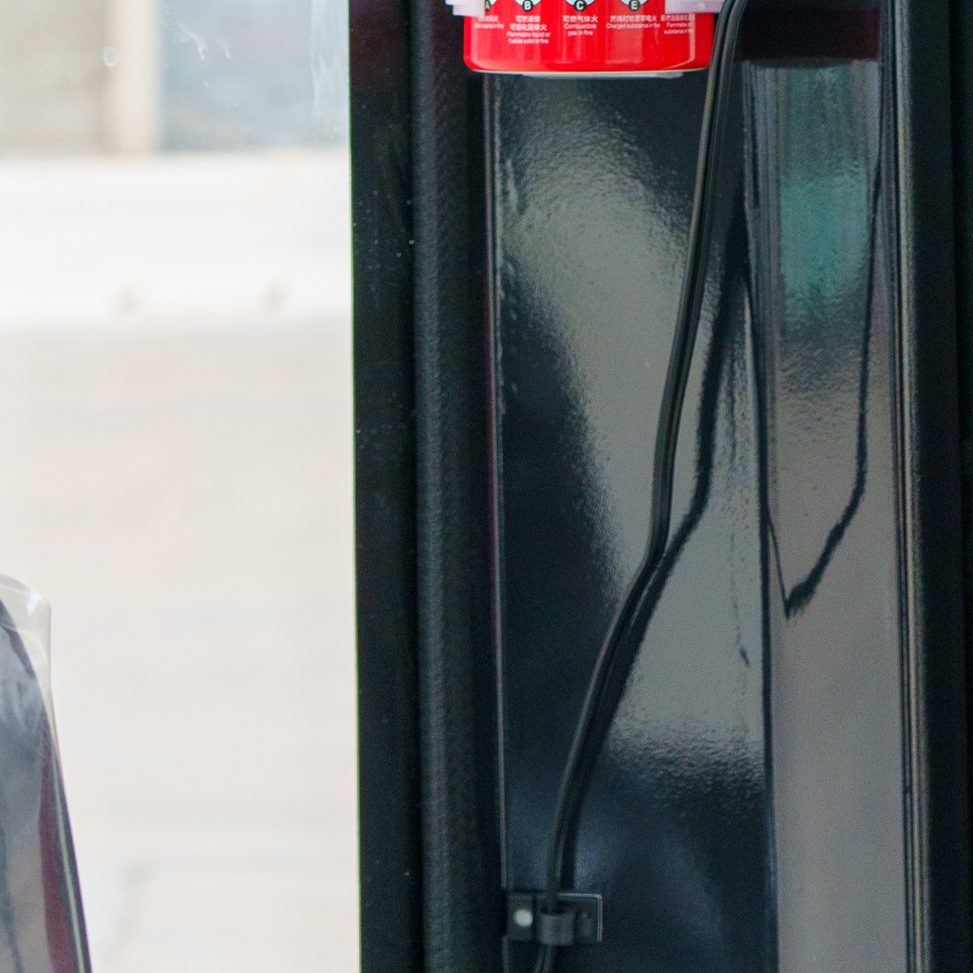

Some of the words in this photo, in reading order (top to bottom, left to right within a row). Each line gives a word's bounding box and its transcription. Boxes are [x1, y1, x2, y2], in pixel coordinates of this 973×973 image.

[524, 0, 531, 11] B
[576, 0, 585, 10] C
[630, 0, 638, 10] E
